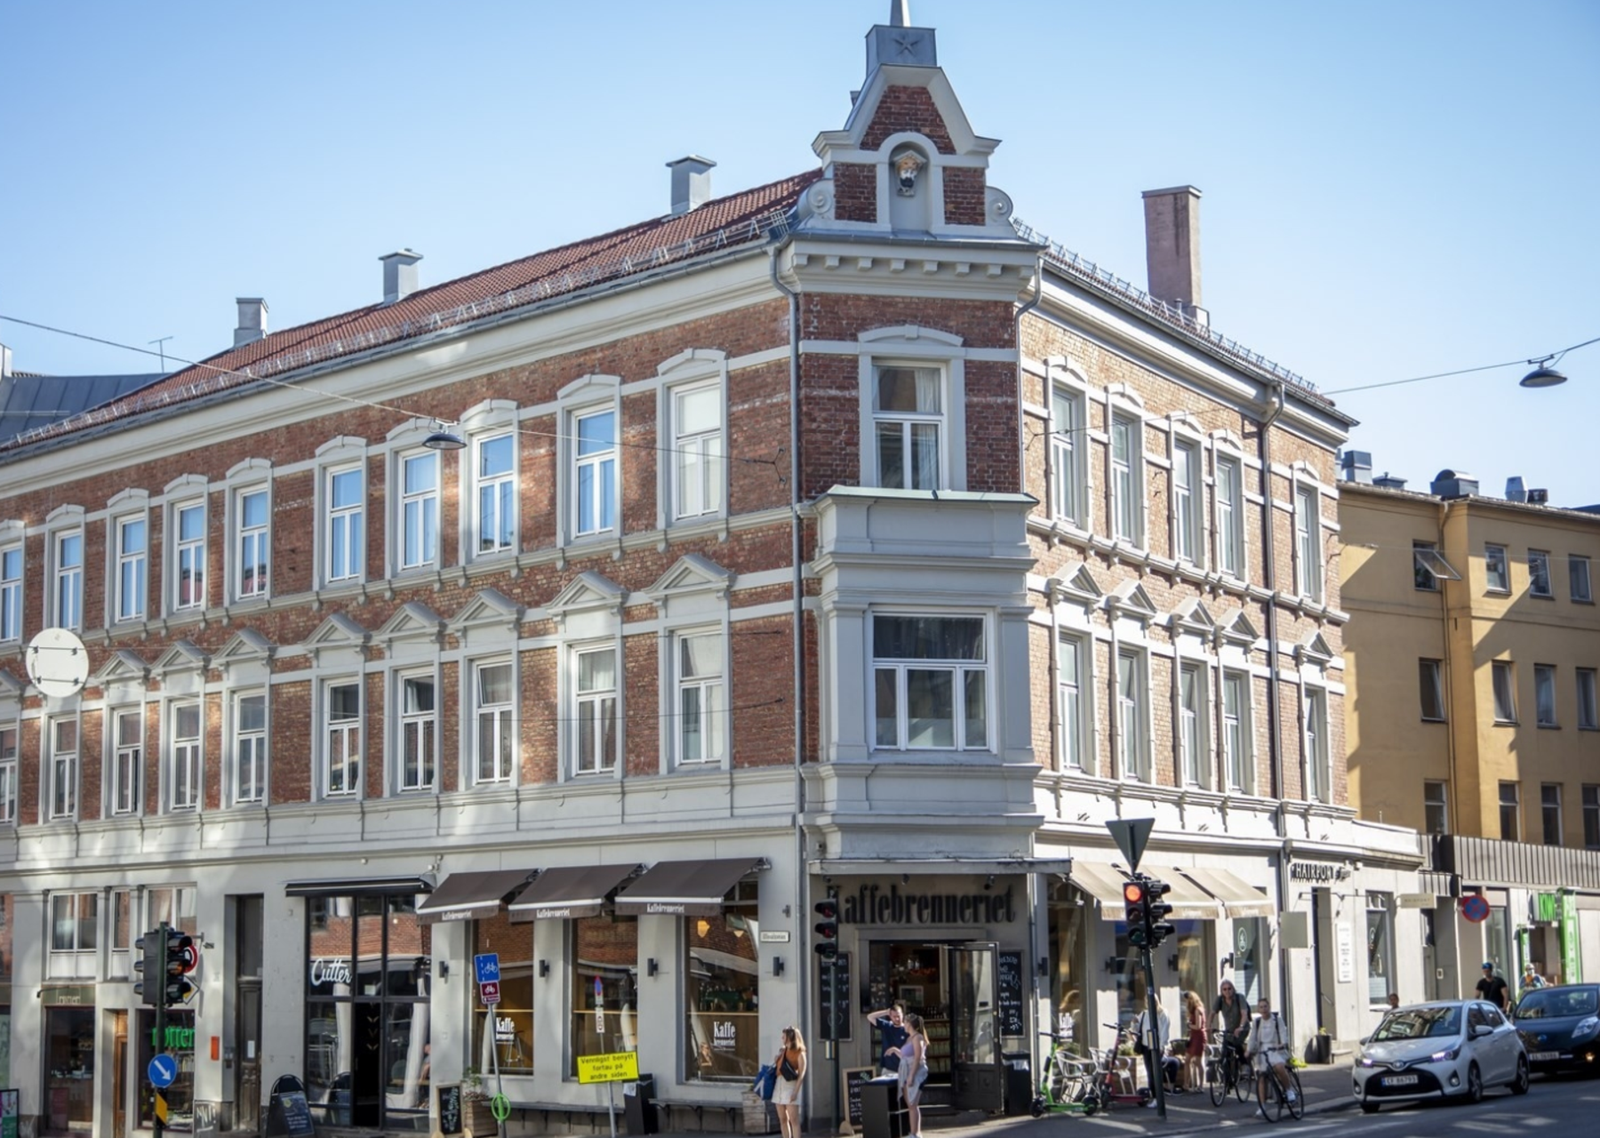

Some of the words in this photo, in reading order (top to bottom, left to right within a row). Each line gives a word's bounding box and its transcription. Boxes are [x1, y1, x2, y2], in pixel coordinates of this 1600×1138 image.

[311, 958, 352, 986] Cutter
[496, 1016, 515, 1032] Kaffe
[713, 1021, 736, 1038] Kaffe
[612, 1053, 634, 1062] benytt
[590, 1072, 608, 1080] andre
[611, 1070, 628, 1078] siden
